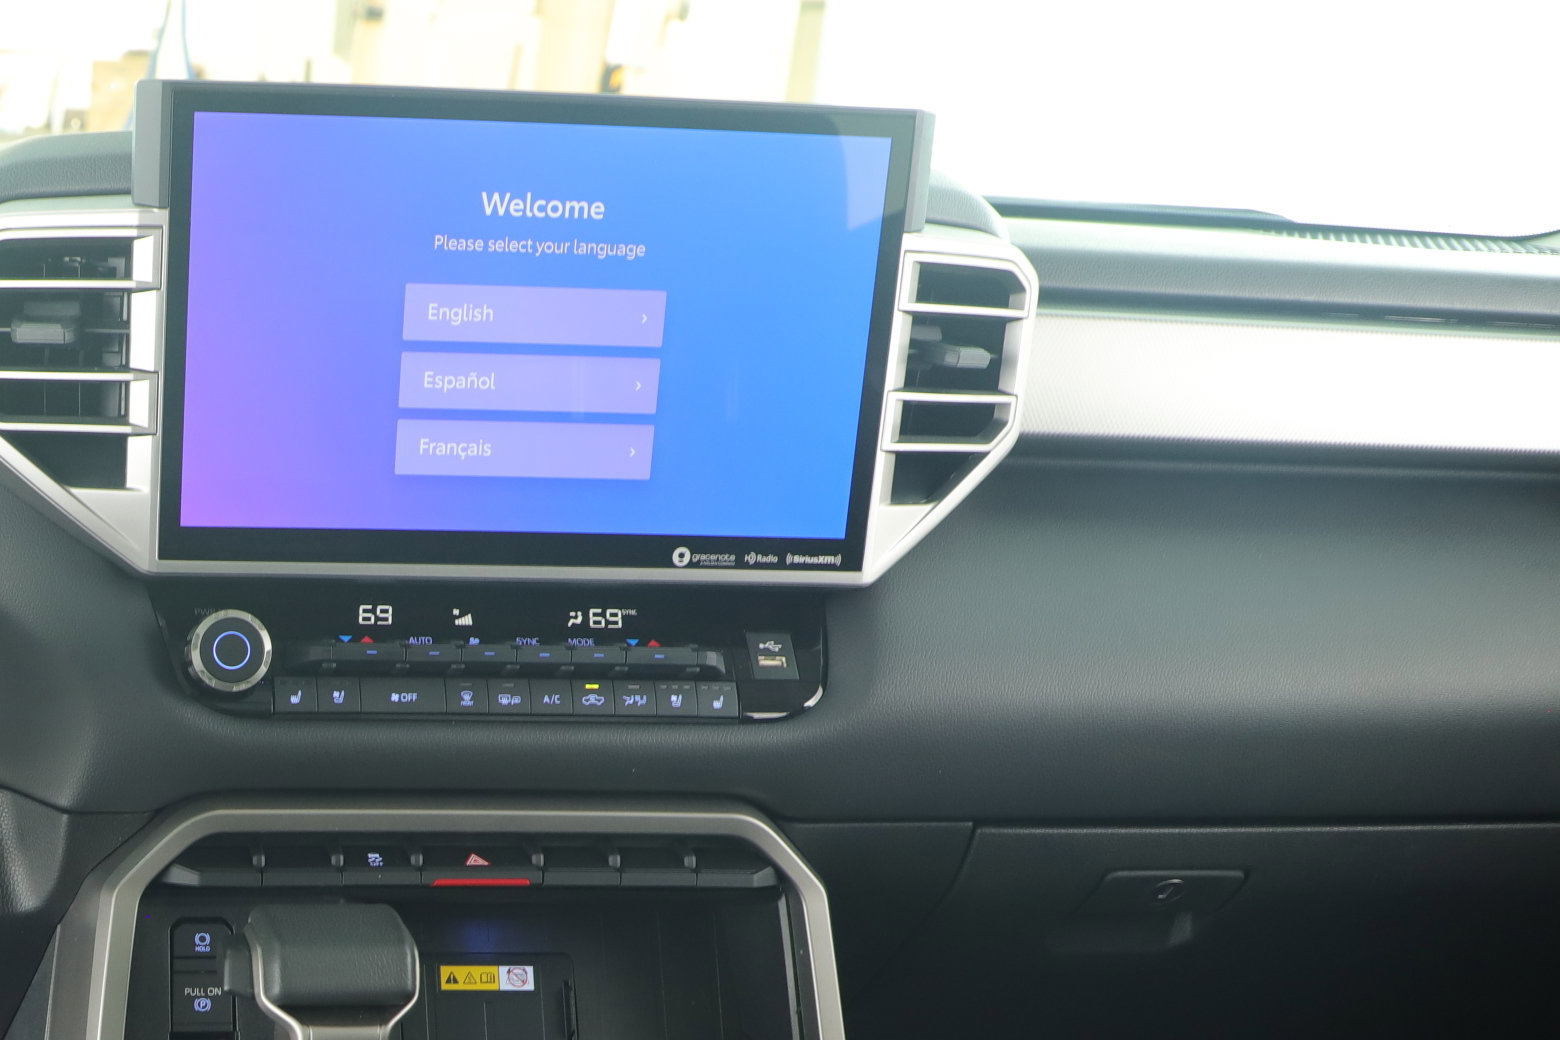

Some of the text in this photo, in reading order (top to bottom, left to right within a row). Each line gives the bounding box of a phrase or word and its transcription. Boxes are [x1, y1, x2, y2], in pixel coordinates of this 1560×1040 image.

[481, 191, 605, 219] Welcome
[434, 234, 646, 260] Please select your language
[428, 303, 494, 325] English
[423, 371, 496, 392] Español
[420, 438, 491, 460] Français
[692, 553, 736, 563] gracenote
[757, 554, 778, 564] Radio
[359, 604, 392, 625] 69
[589, 608, 622, 629] 69
[408, 637, 433, 645] AUTO
[515, 637, 541, 646] SYNC
[567, 638, 596, 647] MODE
[400, 692, 418, 703] OFF
[543, 694, 561, 705] A/C
[184, 987, 222, 997] PULL ON
